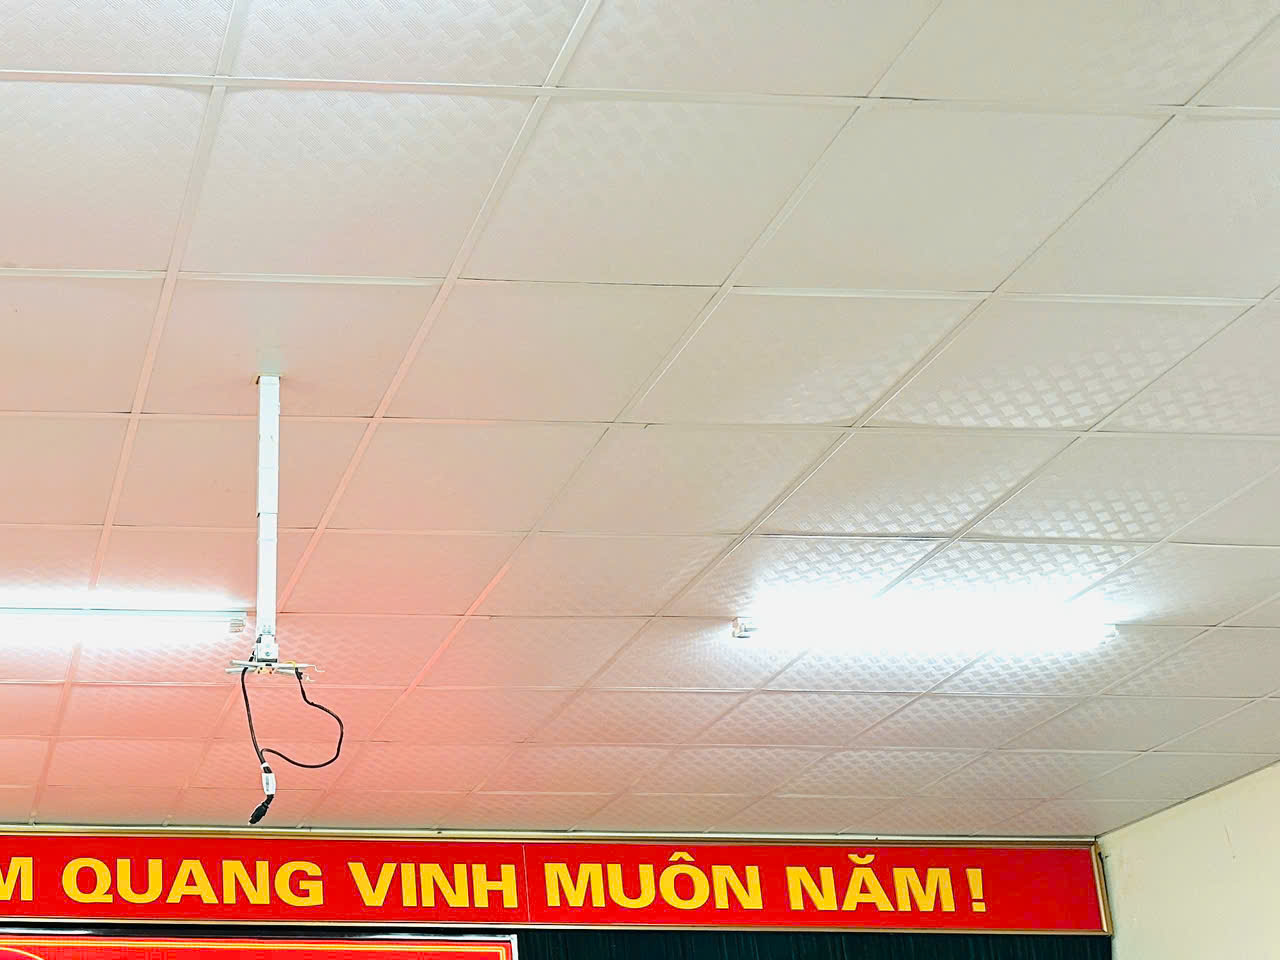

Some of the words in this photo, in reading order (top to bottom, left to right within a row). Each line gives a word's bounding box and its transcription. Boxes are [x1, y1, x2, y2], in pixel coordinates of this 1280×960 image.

[60, 858, 325, 907] QUANG
[347, 861, 519, 909] VINH
[544, 851, 763, 911] MUÔN
